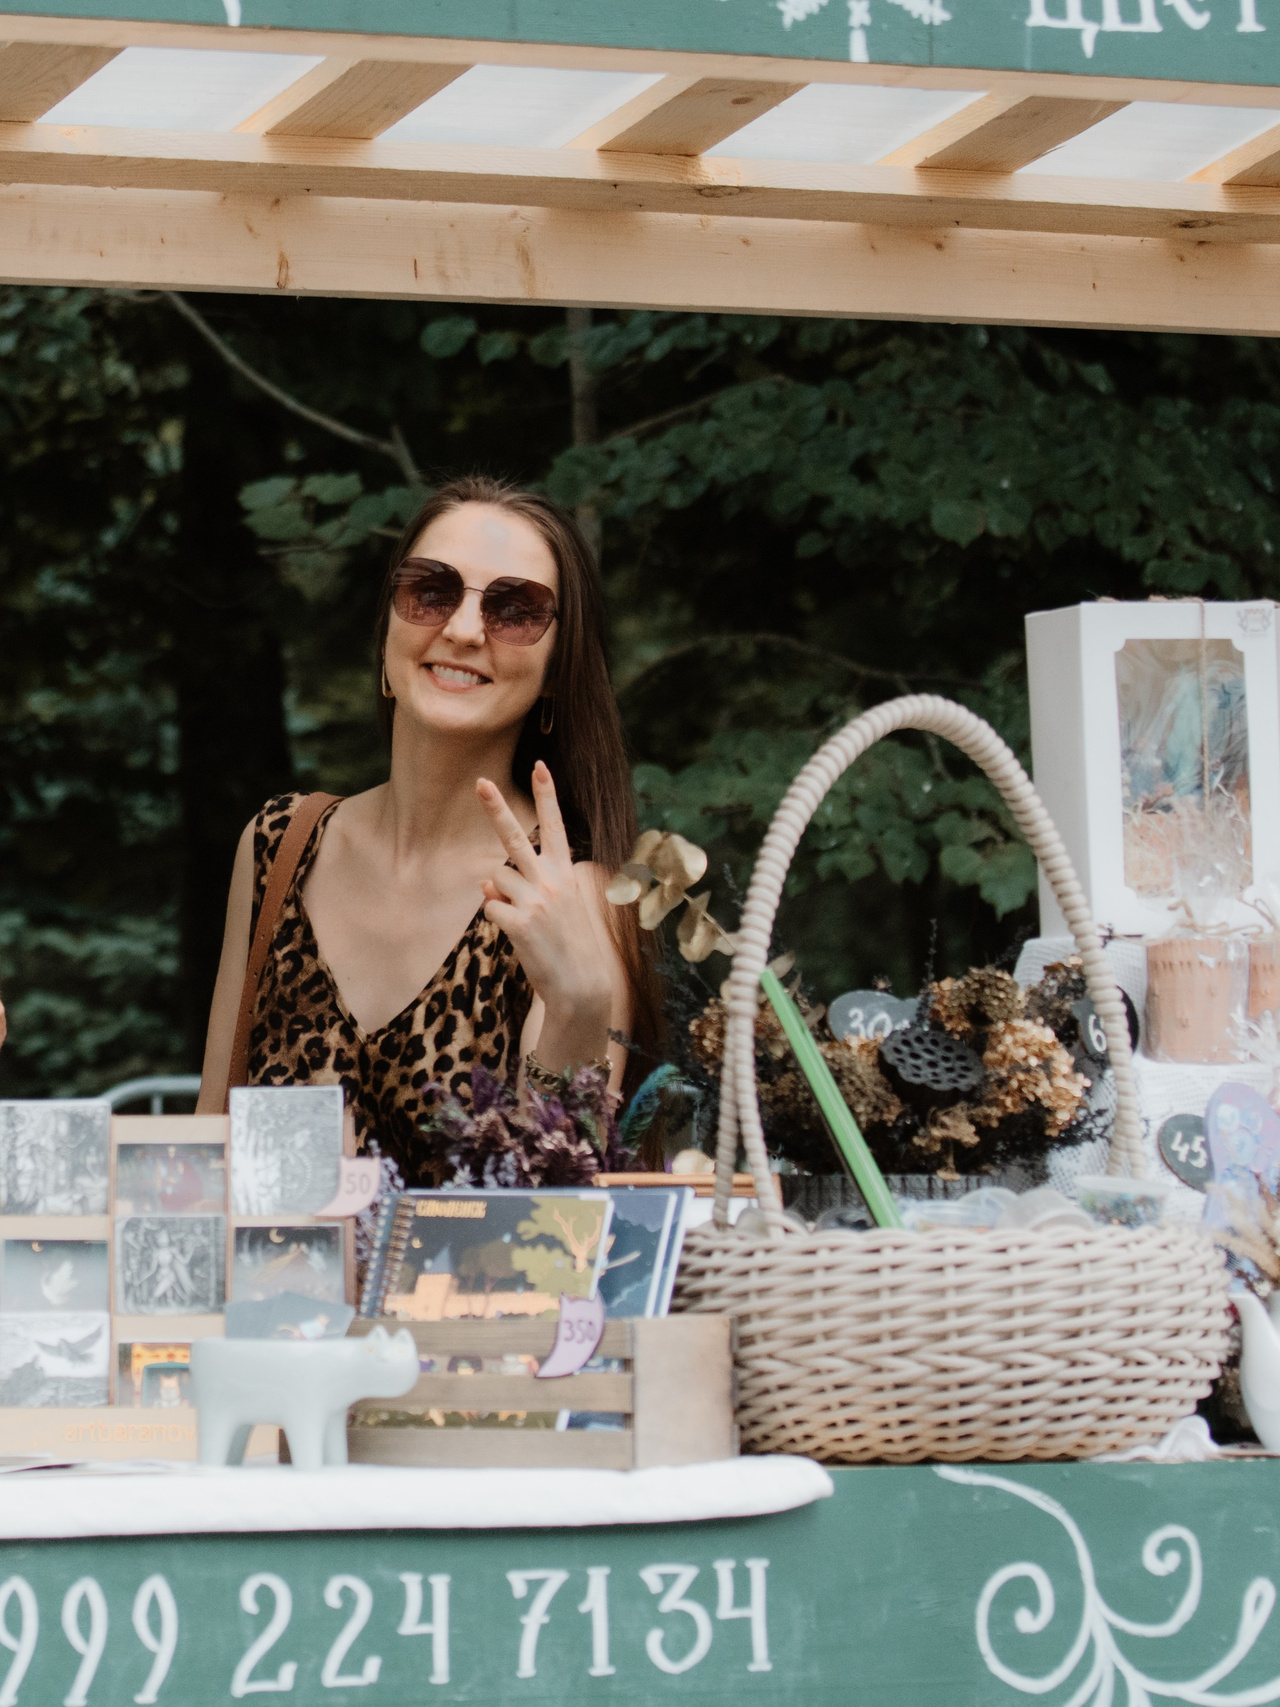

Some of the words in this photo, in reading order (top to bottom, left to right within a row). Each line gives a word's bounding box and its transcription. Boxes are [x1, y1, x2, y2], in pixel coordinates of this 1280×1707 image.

[345, 1173, 372, 1195] 50
[564, 1319, 595, 1344] 350
[230, 1572, 452, 1698] 224
